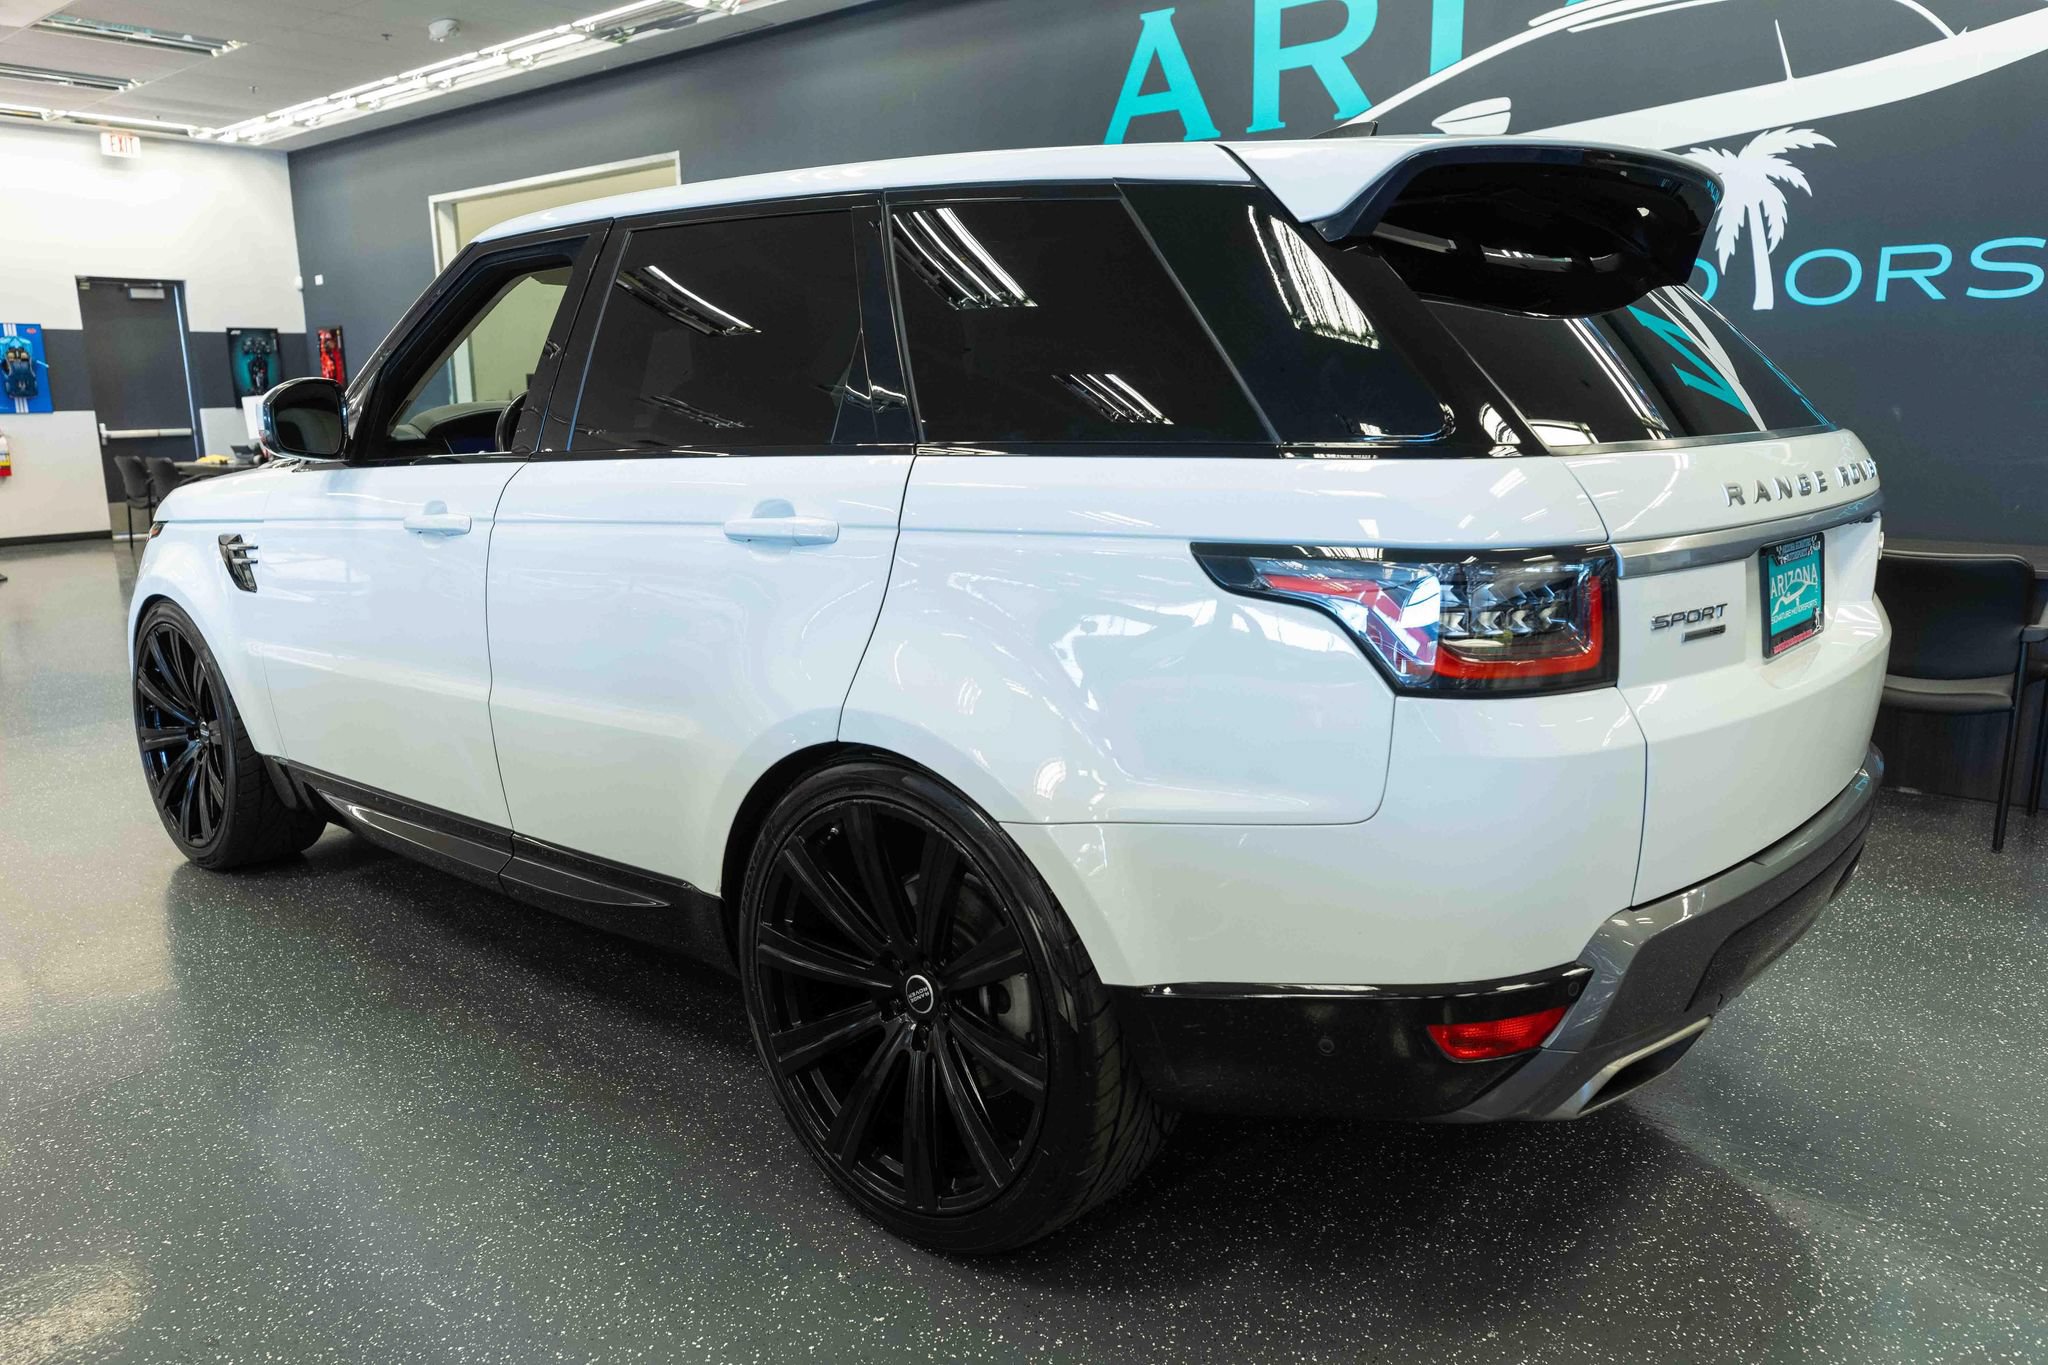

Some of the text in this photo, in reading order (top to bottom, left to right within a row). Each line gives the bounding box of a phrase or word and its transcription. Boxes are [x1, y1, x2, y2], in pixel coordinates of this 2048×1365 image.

[110, 135, 134, 153] EXIT
[1721, 457, 1877, 507] RANGE ROVE
[1770, 562, 1819, 599] ARIZONA
[1650, 603, 1728, 631] SPORT
